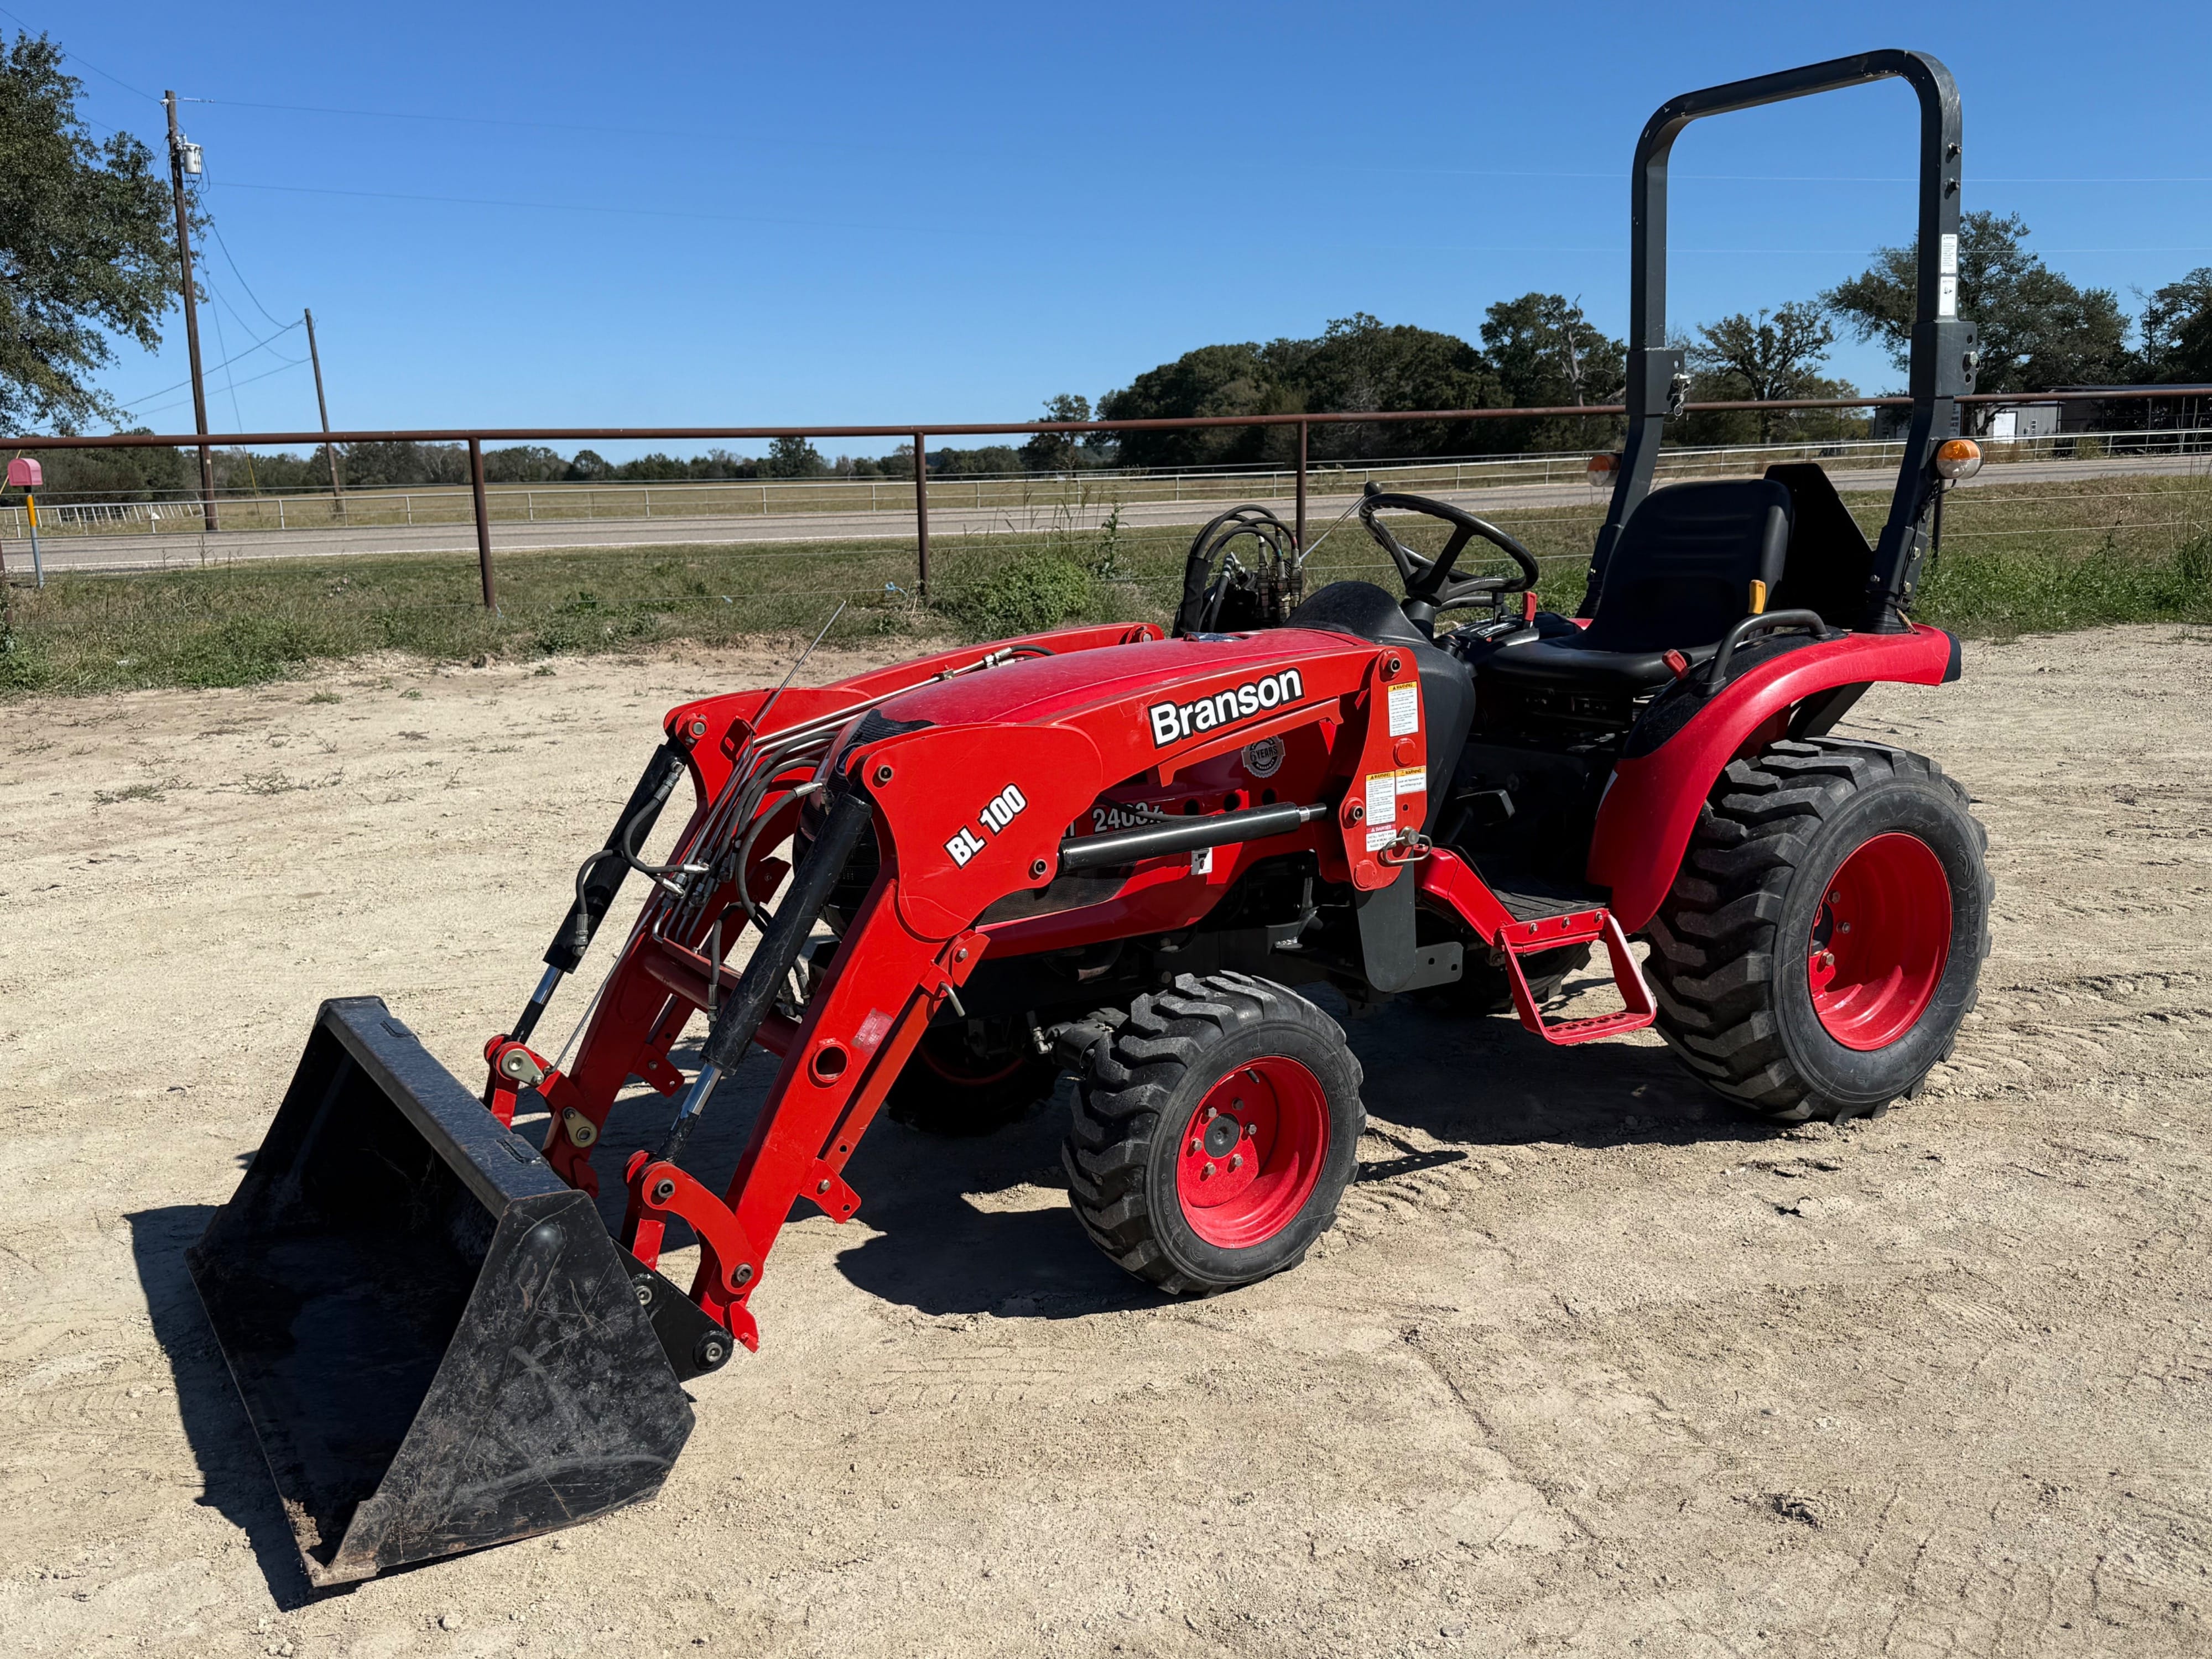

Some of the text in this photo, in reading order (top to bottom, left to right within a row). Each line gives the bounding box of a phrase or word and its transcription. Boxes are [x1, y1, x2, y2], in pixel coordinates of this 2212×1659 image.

[1152, 669, 1302, 746] Branson
[1256, 745, 1278, 759] YEARS
[947, 830, 977, 864] BL
[980, 787, 1023, 832] 100
